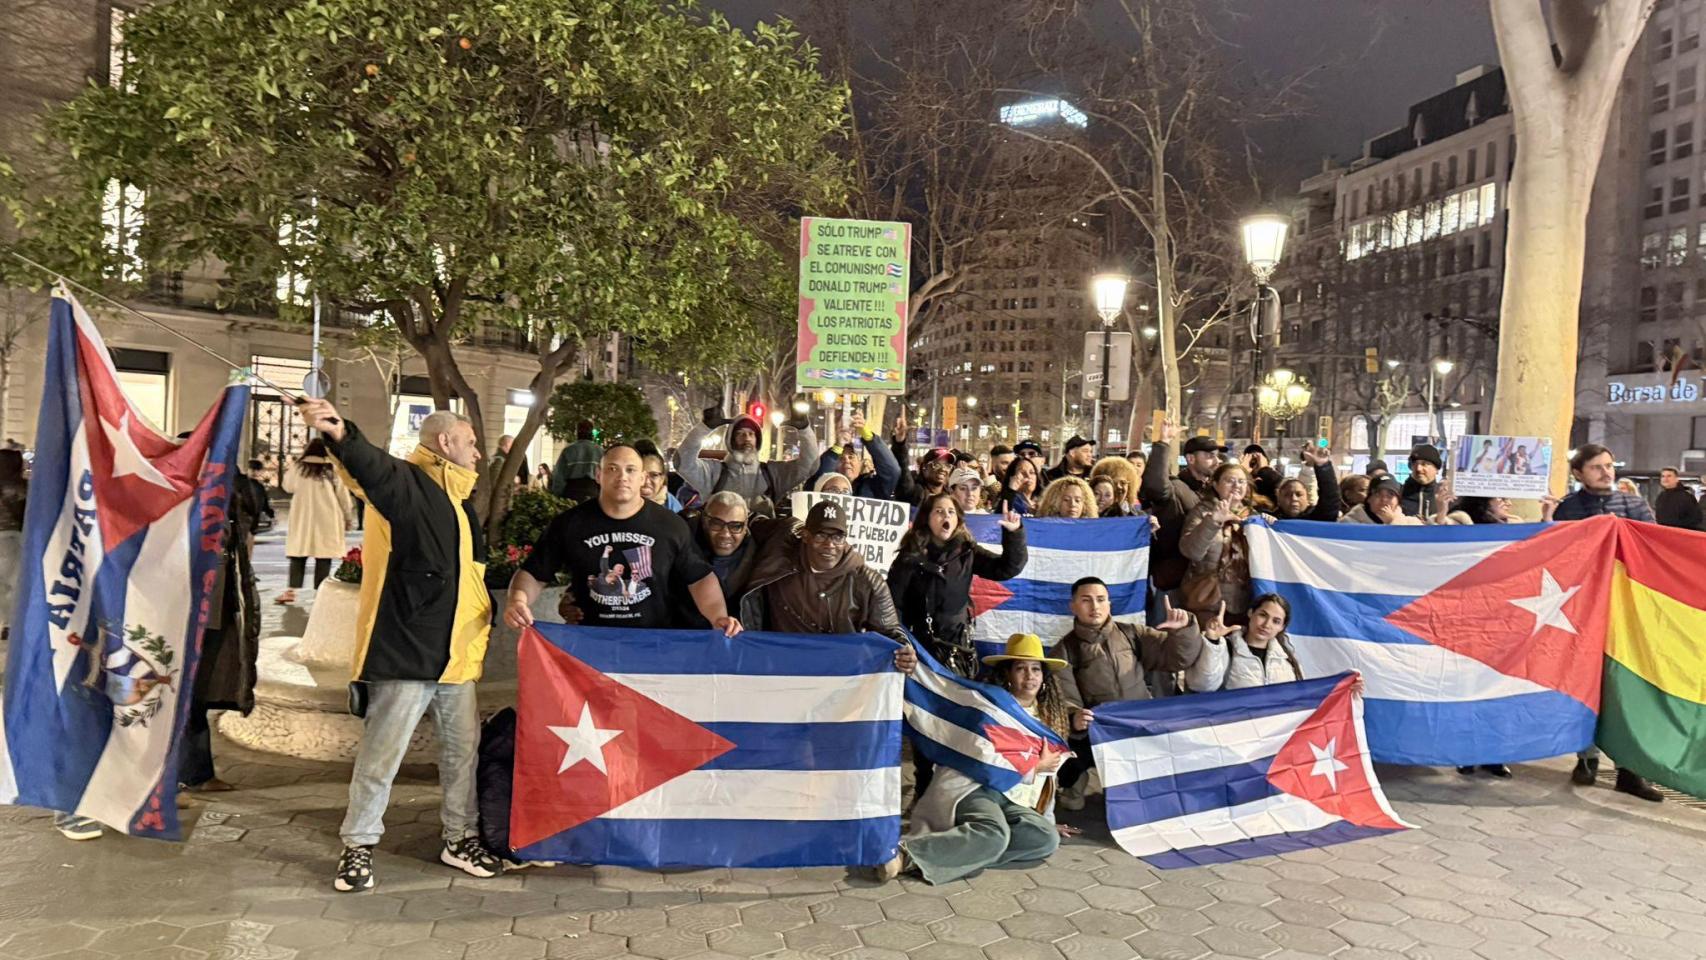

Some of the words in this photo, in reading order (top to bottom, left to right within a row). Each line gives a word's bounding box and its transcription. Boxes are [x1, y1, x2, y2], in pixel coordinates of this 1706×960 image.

[818, 222, 845, 238] SÓLO
[847, 226, 882, 240] TRUMP
[817, 244, 830, 256] SE
[832, 245, 872, 257] ATREVE
[876, 246, 897, 258] CON
[810, 261, 823, 273] EL
[825, 262, 885, 275] COMUNISMO
[809, 280, 851, 293] DONALD
[853, 281, 887, 293] TRUMP
[824, 299, 872, 311] VALIENTE
[817, 316, 838, 328] LOS
[839, 316, 892, 329] PATRIOTAS
[826, 334, 867, 346] BUENOS
[872, 335, 885, 347] TE
[819, 351, 875, 363] DEFIENDEN
[1608, 382, 1666, 404] Borsa
[1670, 377, 1697, 402] de
[807, 494, 906, 526] LERTAD
[858, 525, 898, 542] PUEBLO
[584, 533, 610, 549] YOU
